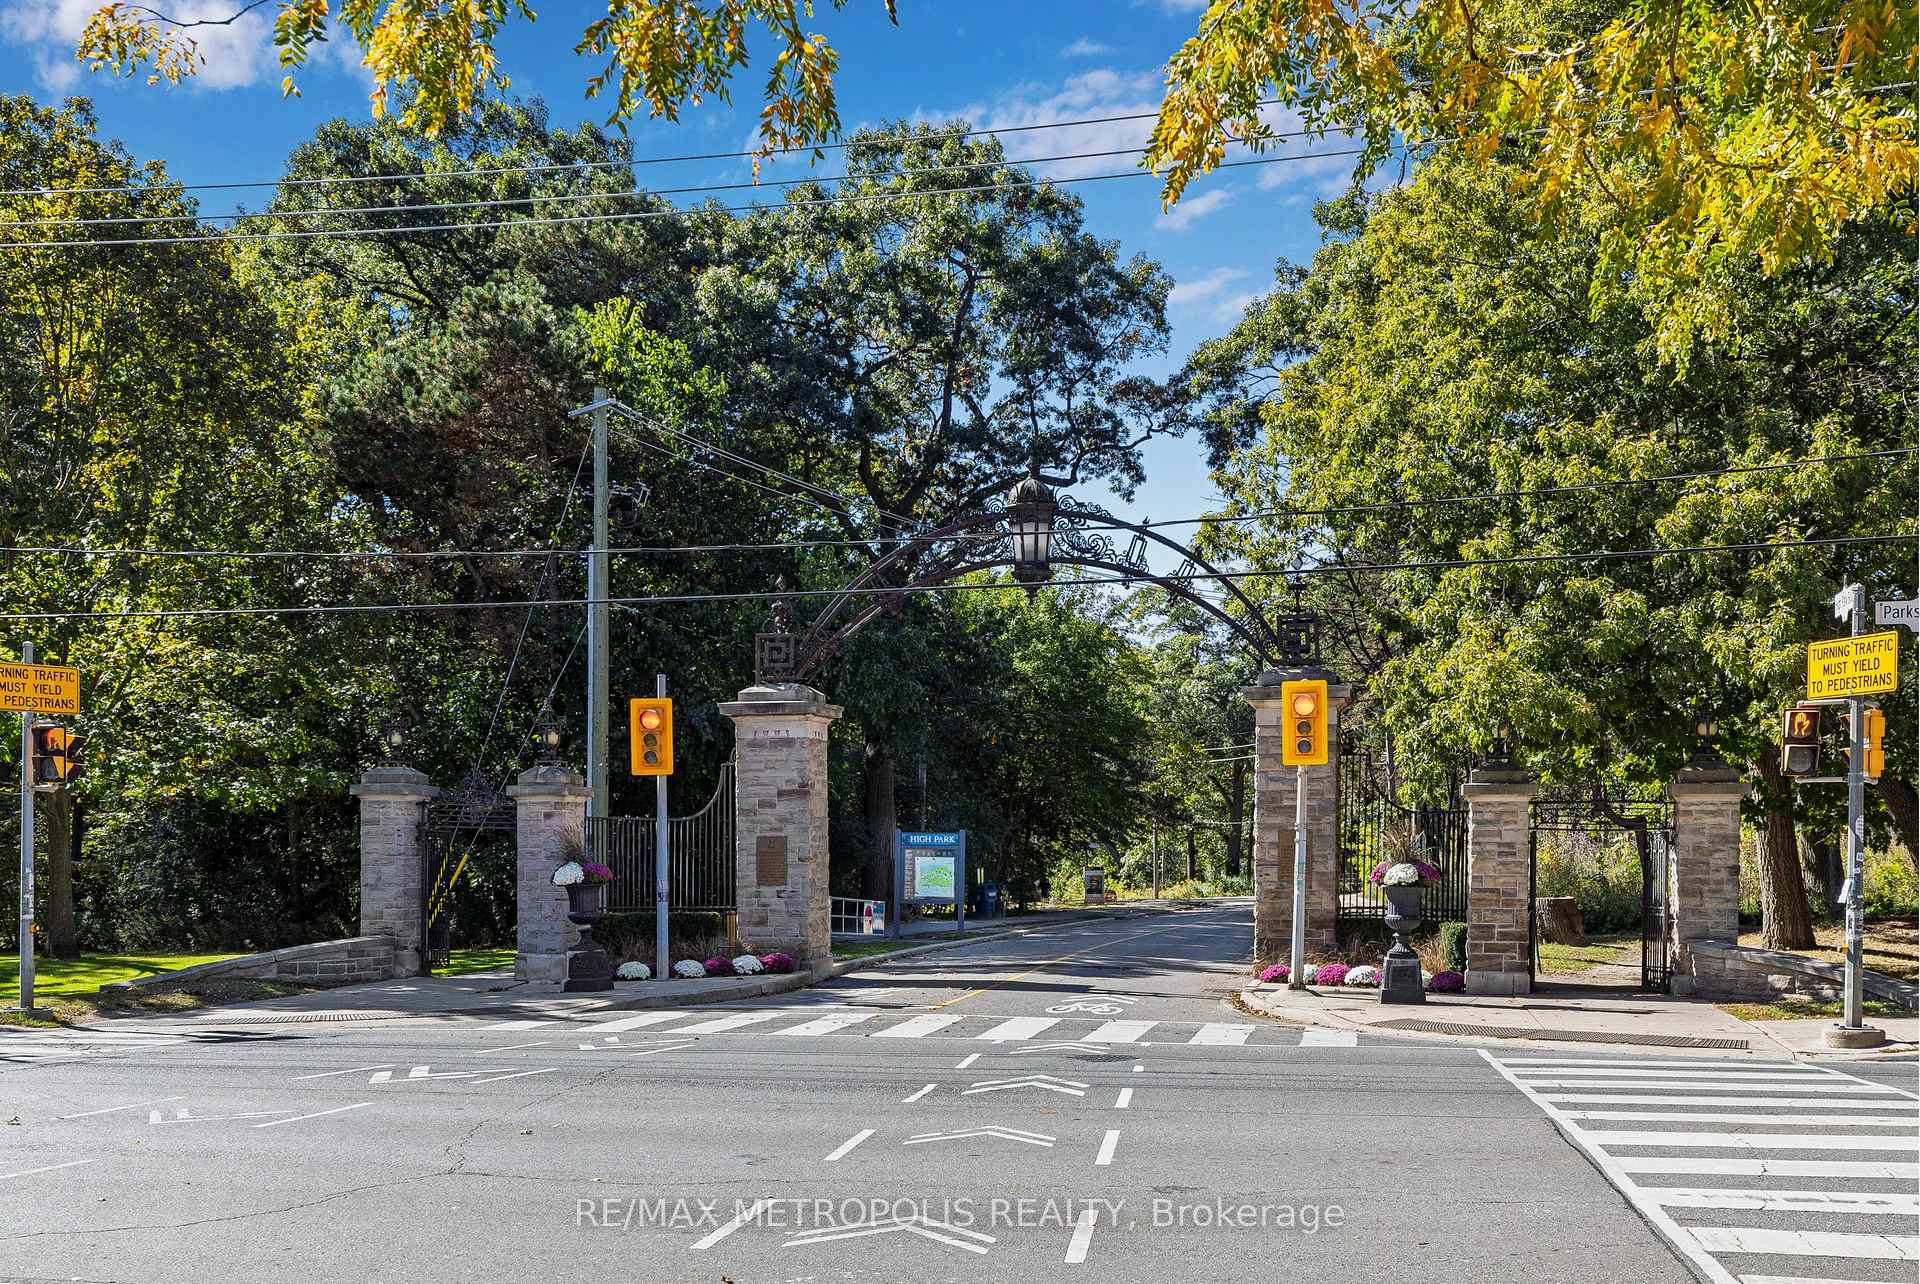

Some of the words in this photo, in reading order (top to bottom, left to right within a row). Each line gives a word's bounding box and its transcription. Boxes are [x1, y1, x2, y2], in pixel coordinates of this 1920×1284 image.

[1812, 645, 1850, 660] TURNING
[1854, 639, 1894, 656] TRAFFIC
[1823, 662, 1848, 676] MUST
[1853, 658, 1880, 673] YIELD
[34, 670, 75, 683] TRAFFIC
[1812, 681, 1823, 694] TO
[1828, 673, 1892, 692] PEDESTRIANS
[0, 682, 27, 693] MUST
[33, 684, 62, 696] YIELD
[4, 695, 75, 710] PEDESTRIANS
[910, 835, 931, 843] HIGH
[934, 835, 956, 843] PARK
